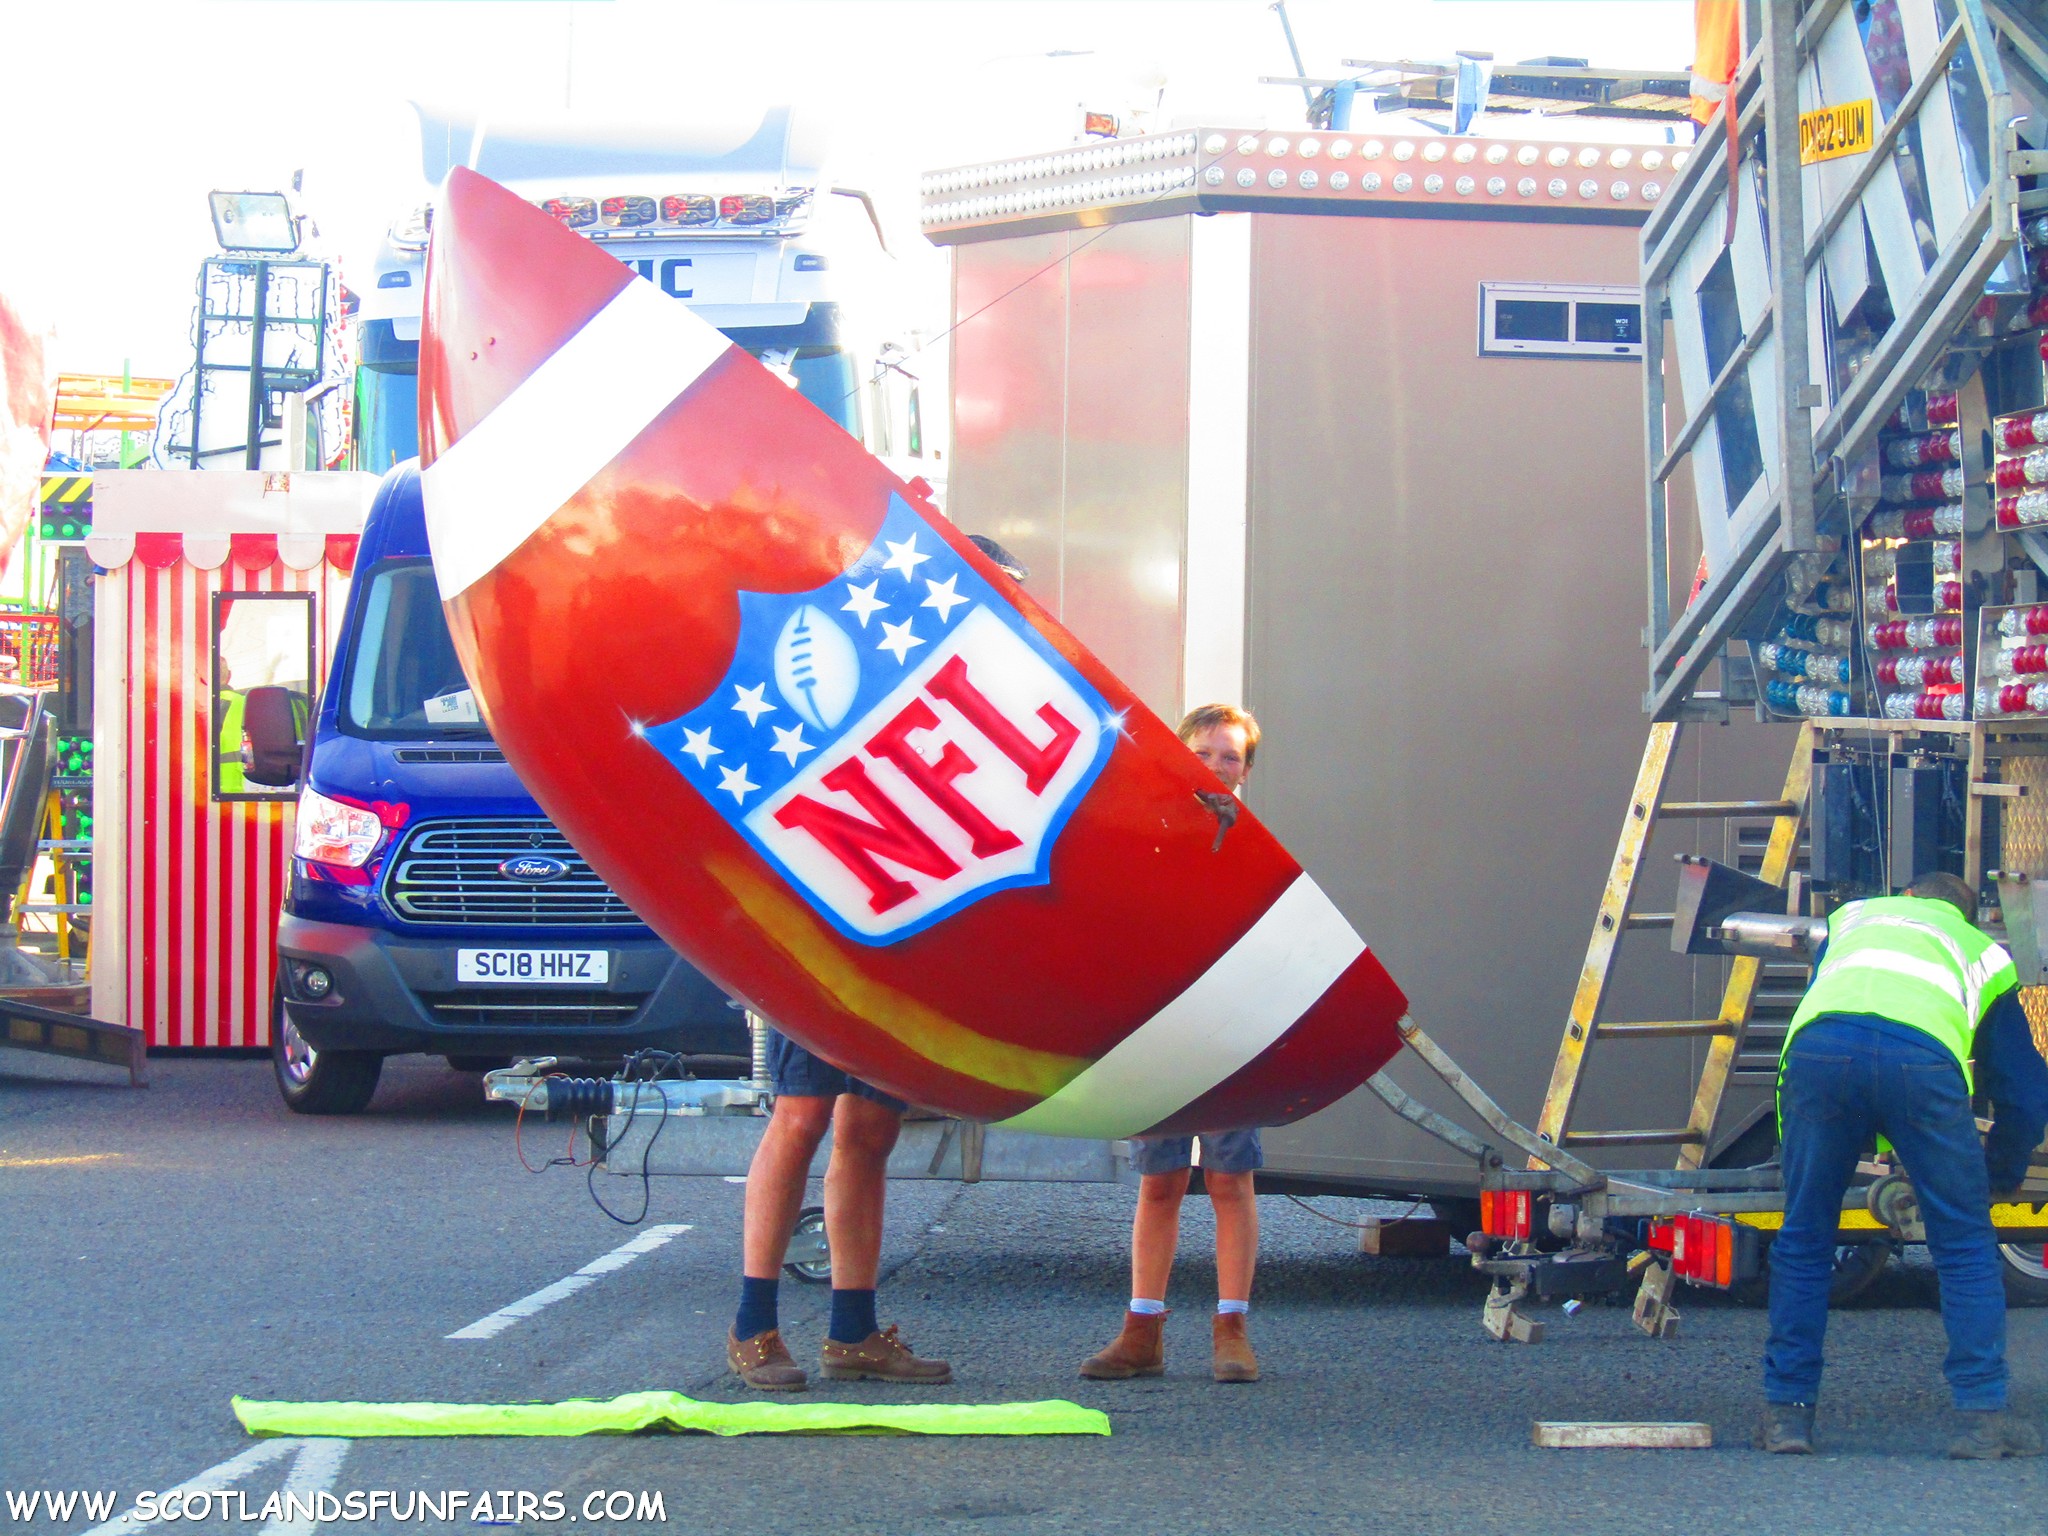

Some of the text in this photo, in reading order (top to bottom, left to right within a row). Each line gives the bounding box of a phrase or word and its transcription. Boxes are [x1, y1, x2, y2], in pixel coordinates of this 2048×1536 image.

[773, 654, 1081, 915] NFL
[514, 860, 551, 875] Ford
[475, 952, 591, 977] SC18 HHZ
